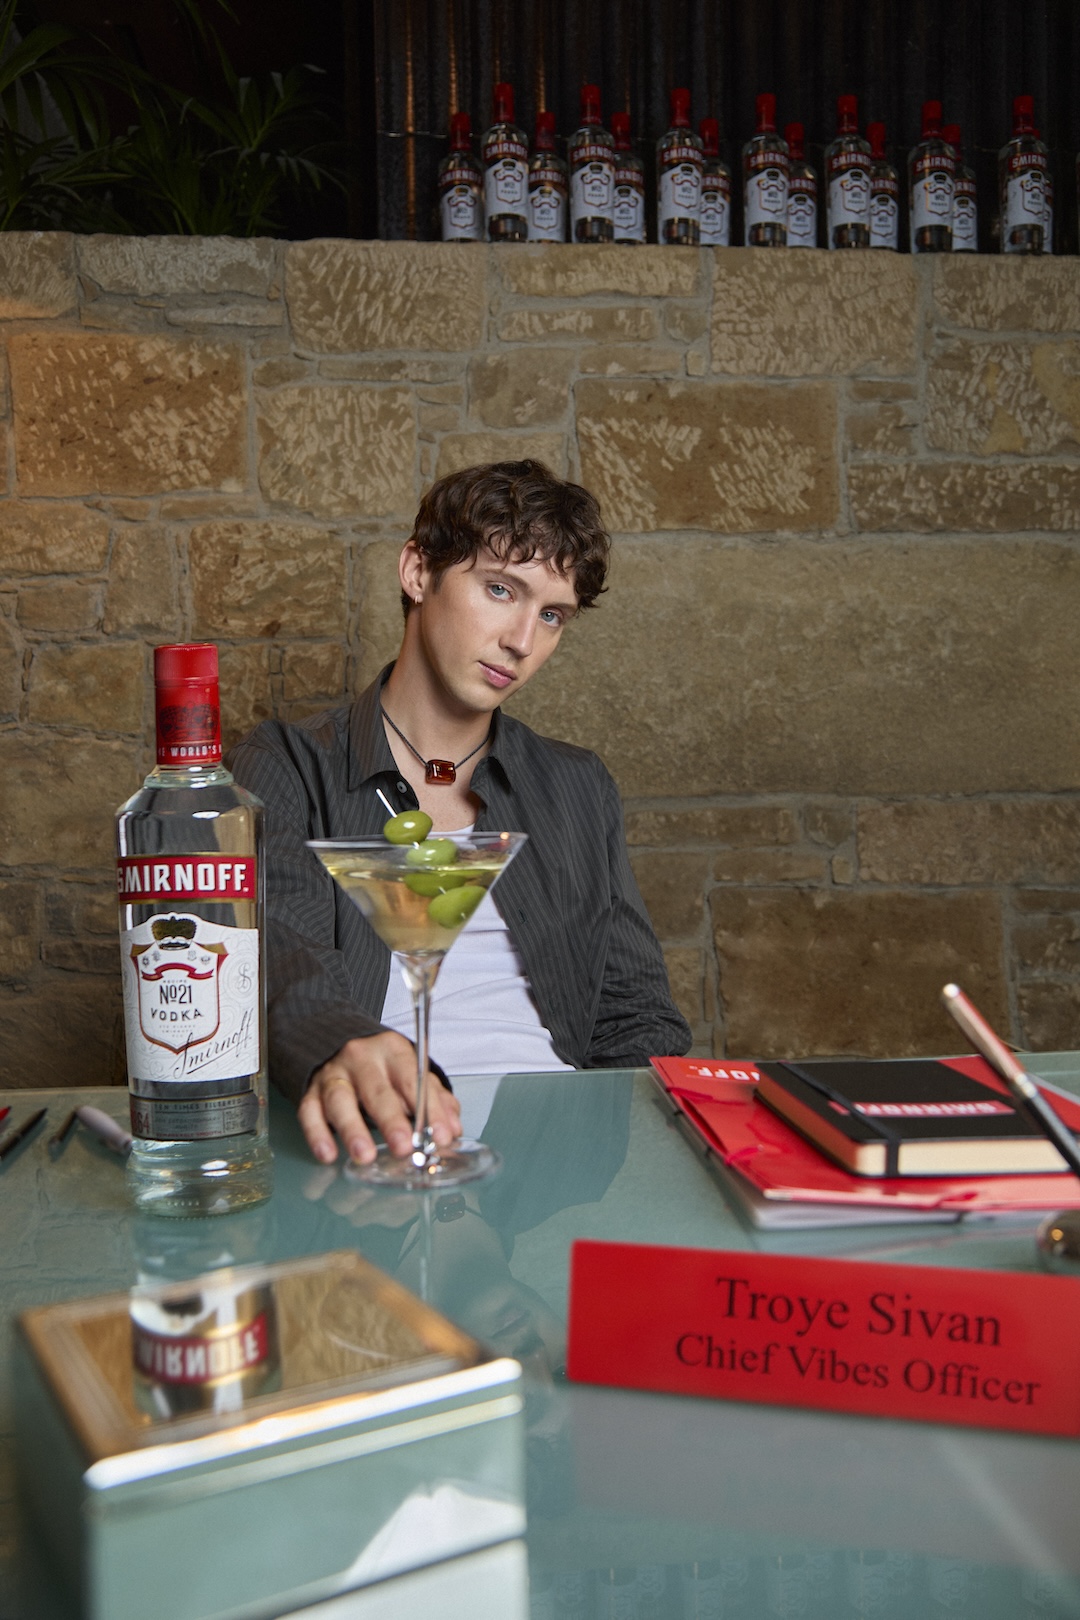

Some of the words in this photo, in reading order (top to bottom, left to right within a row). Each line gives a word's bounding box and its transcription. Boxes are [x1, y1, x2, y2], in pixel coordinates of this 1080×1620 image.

[171, 745, 216, 757] WORLD'S
[150, 1008, 205, 1022] VODKA
[717, 1277, 850, 1337] Troye
[868, 1294, 1002, 1347] Sivan
[675, 1333, 781, 1375] Chief
[787, 1345, 889, 1389] Vibes
[902, 1358, 1042, 1405] Officer
